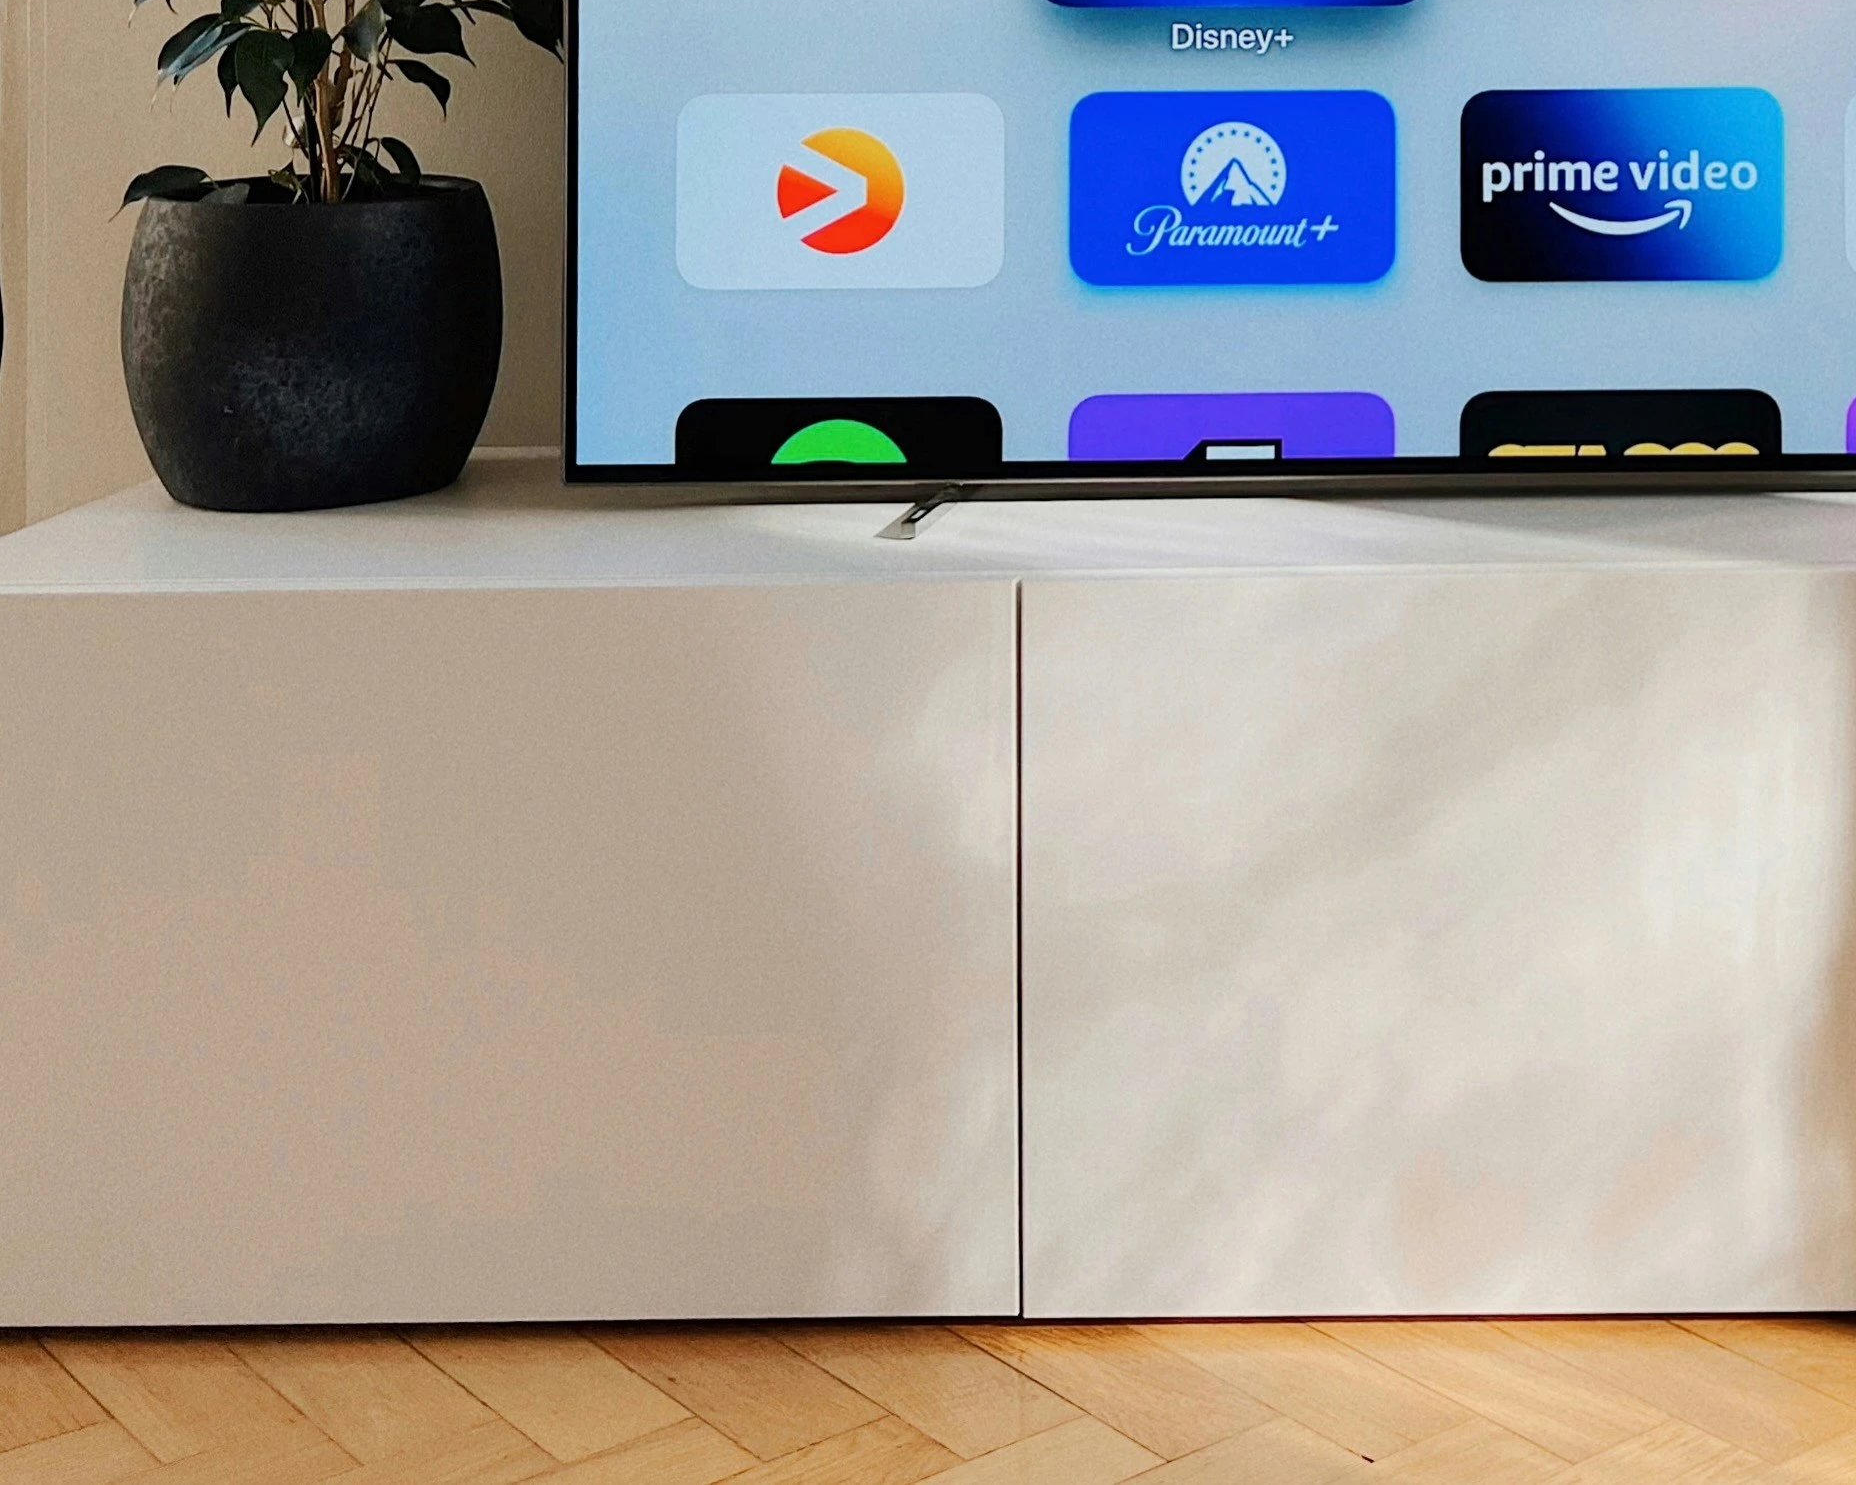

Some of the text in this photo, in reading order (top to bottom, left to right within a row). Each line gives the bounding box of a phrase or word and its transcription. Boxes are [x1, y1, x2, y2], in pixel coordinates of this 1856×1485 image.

[1171, 23, 1295, 54] Disney+
[1482, 149, 1758, 202] prime video
[1126, 205, 1339, 255] Paramount+
